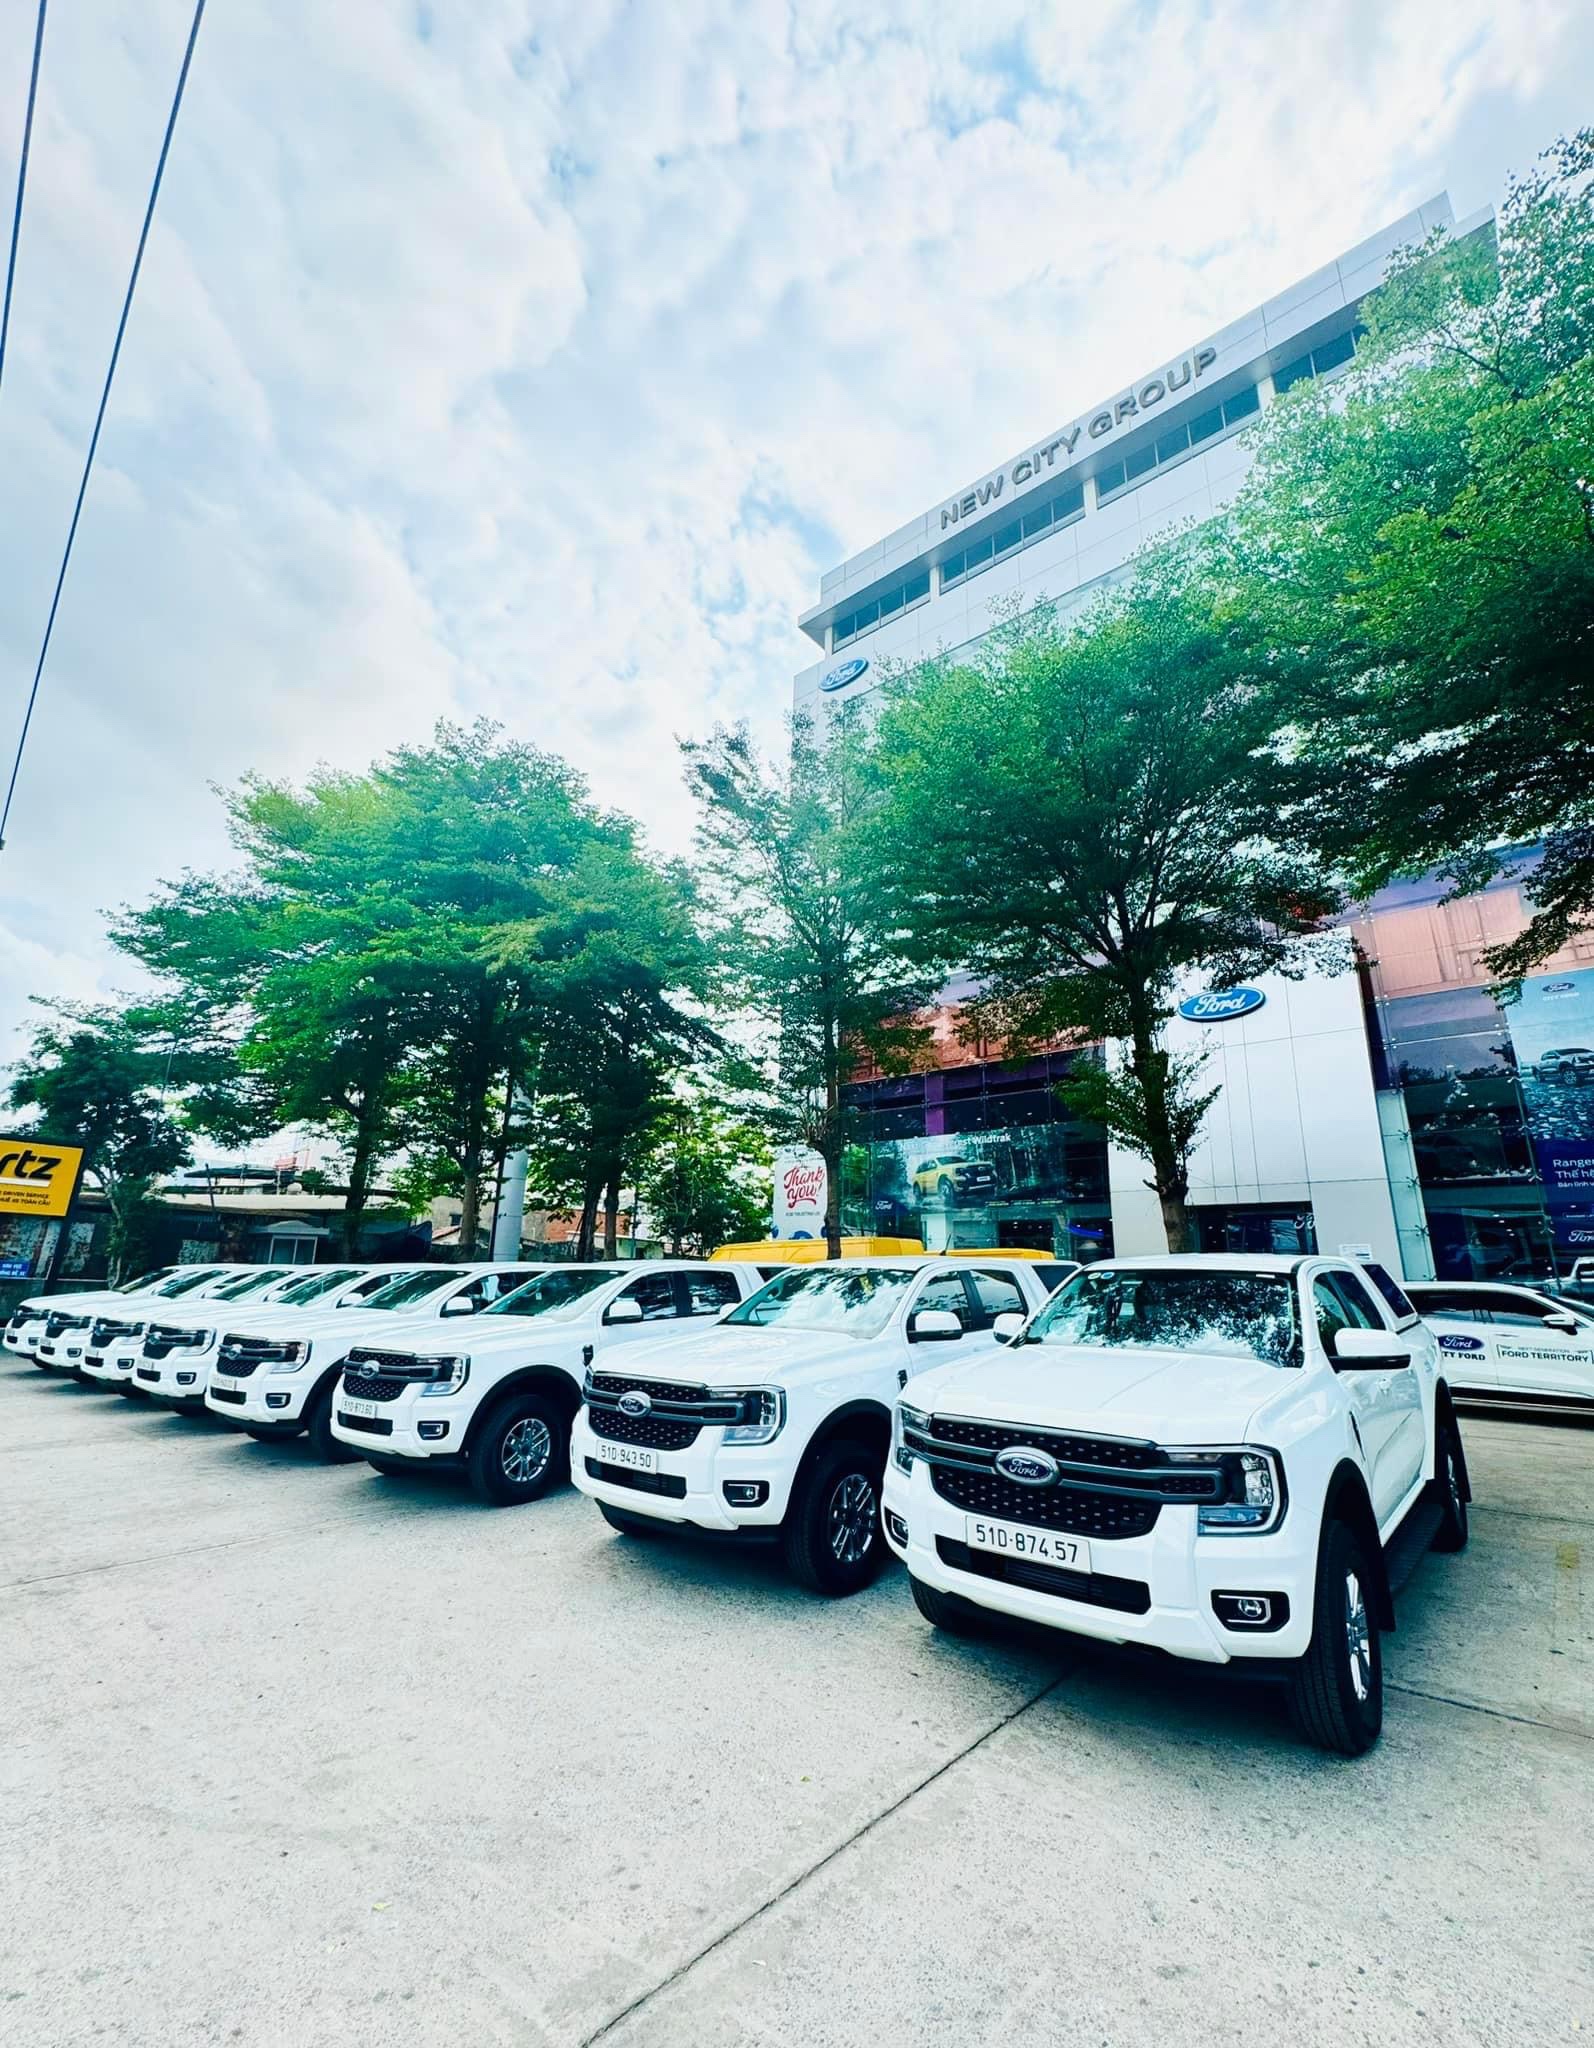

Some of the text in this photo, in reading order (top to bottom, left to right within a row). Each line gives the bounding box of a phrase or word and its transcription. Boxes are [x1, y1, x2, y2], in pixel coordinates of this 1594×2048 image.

[940, 347, 1217, 530] NEW CITY GROUP
[1193, 991, 1247, 1015] Ford
[784, 1166, 825, 1189] Thank
[1443, 1336, 1473, 1348] Ford
[1458, 1352, 1486, 1361] FORD
[1501, 1350, 1589, 1362] FORD TERRITORY
[1009, 1458, 1039, 1477] Ford
